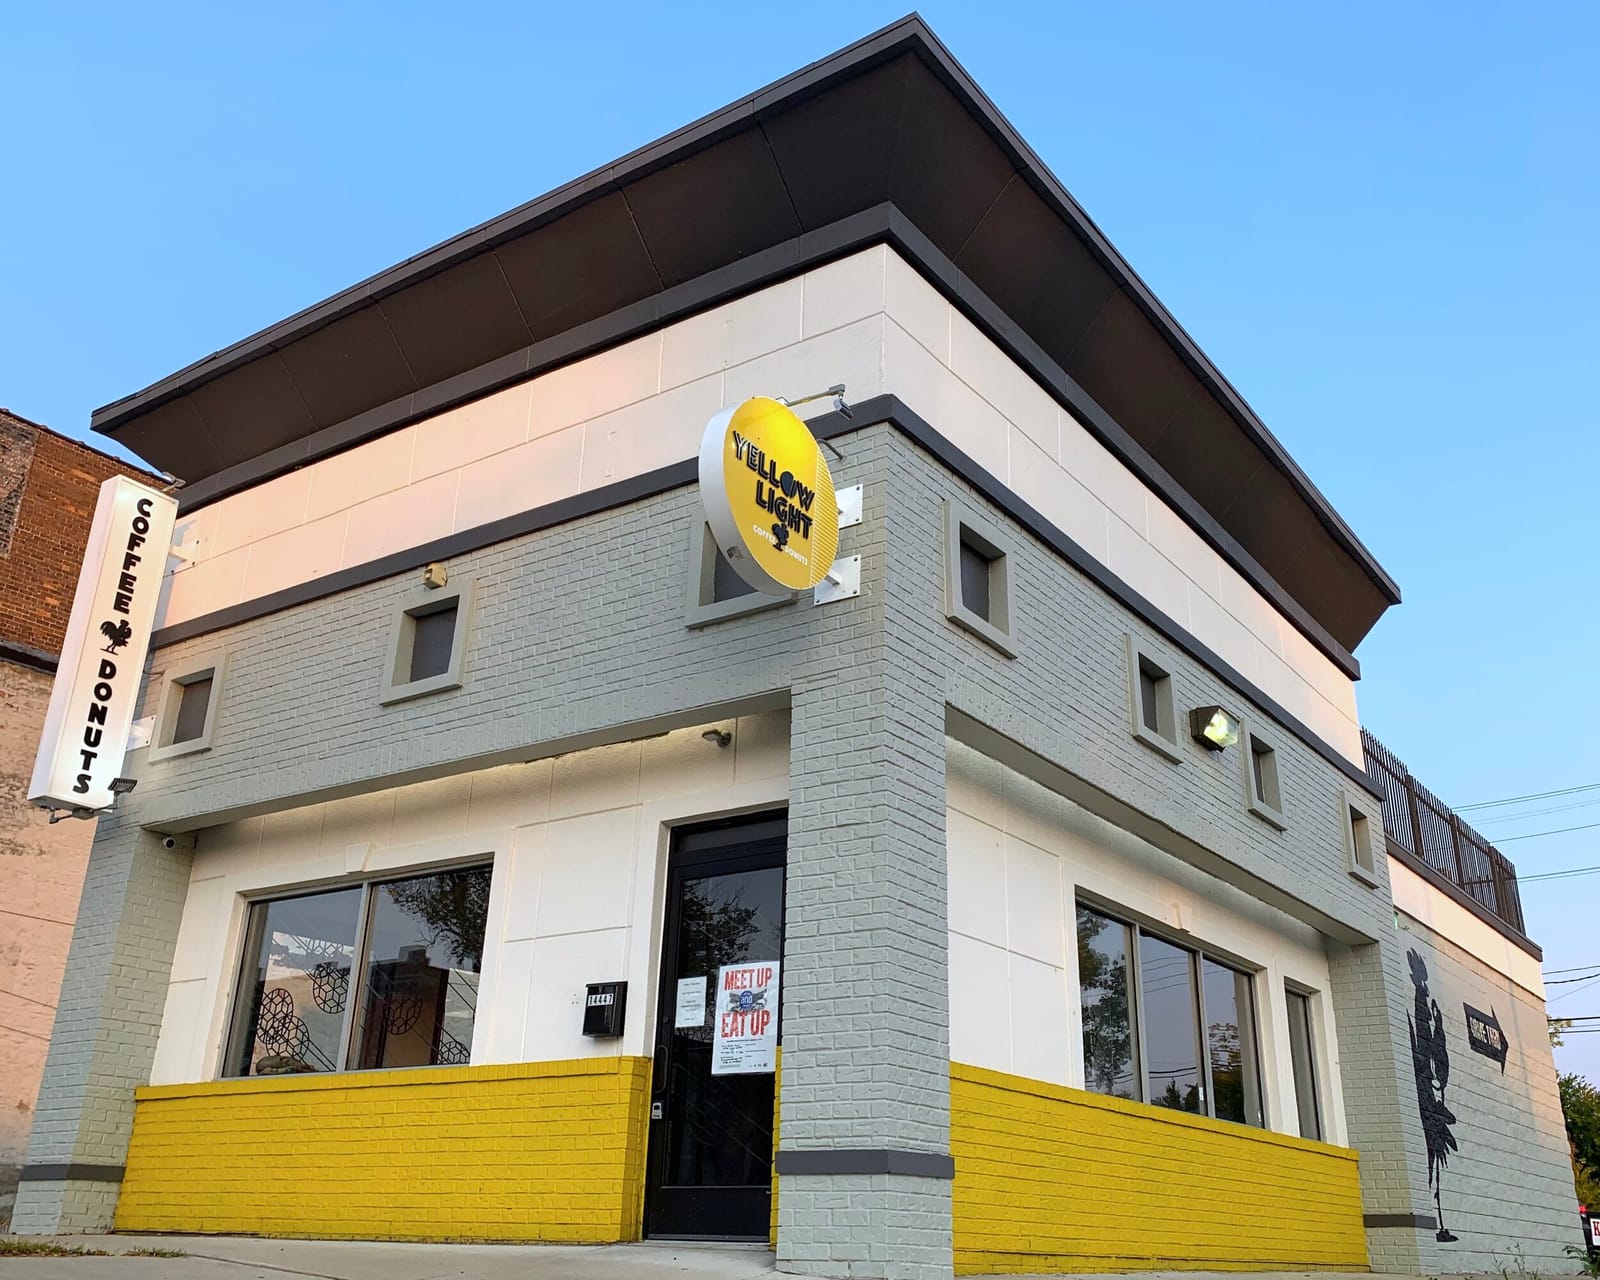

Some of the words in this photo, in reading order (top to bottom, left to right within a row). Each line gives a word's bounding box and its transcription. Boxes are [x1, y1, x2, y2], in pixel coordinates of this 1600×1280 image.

[733, 430, 815, 511] YELLOW
[756, 480, 813, 539] LIGHT
[111, 498, 154, 615] COFFEE
[72, 658, 117, 794] DONUTS
[725, 969, 755, 991] MEET
[756, 967, 772, 988] UP
[721, 1010, 748, 1038] EAT
[750, 1009, 770, 1036] UP
